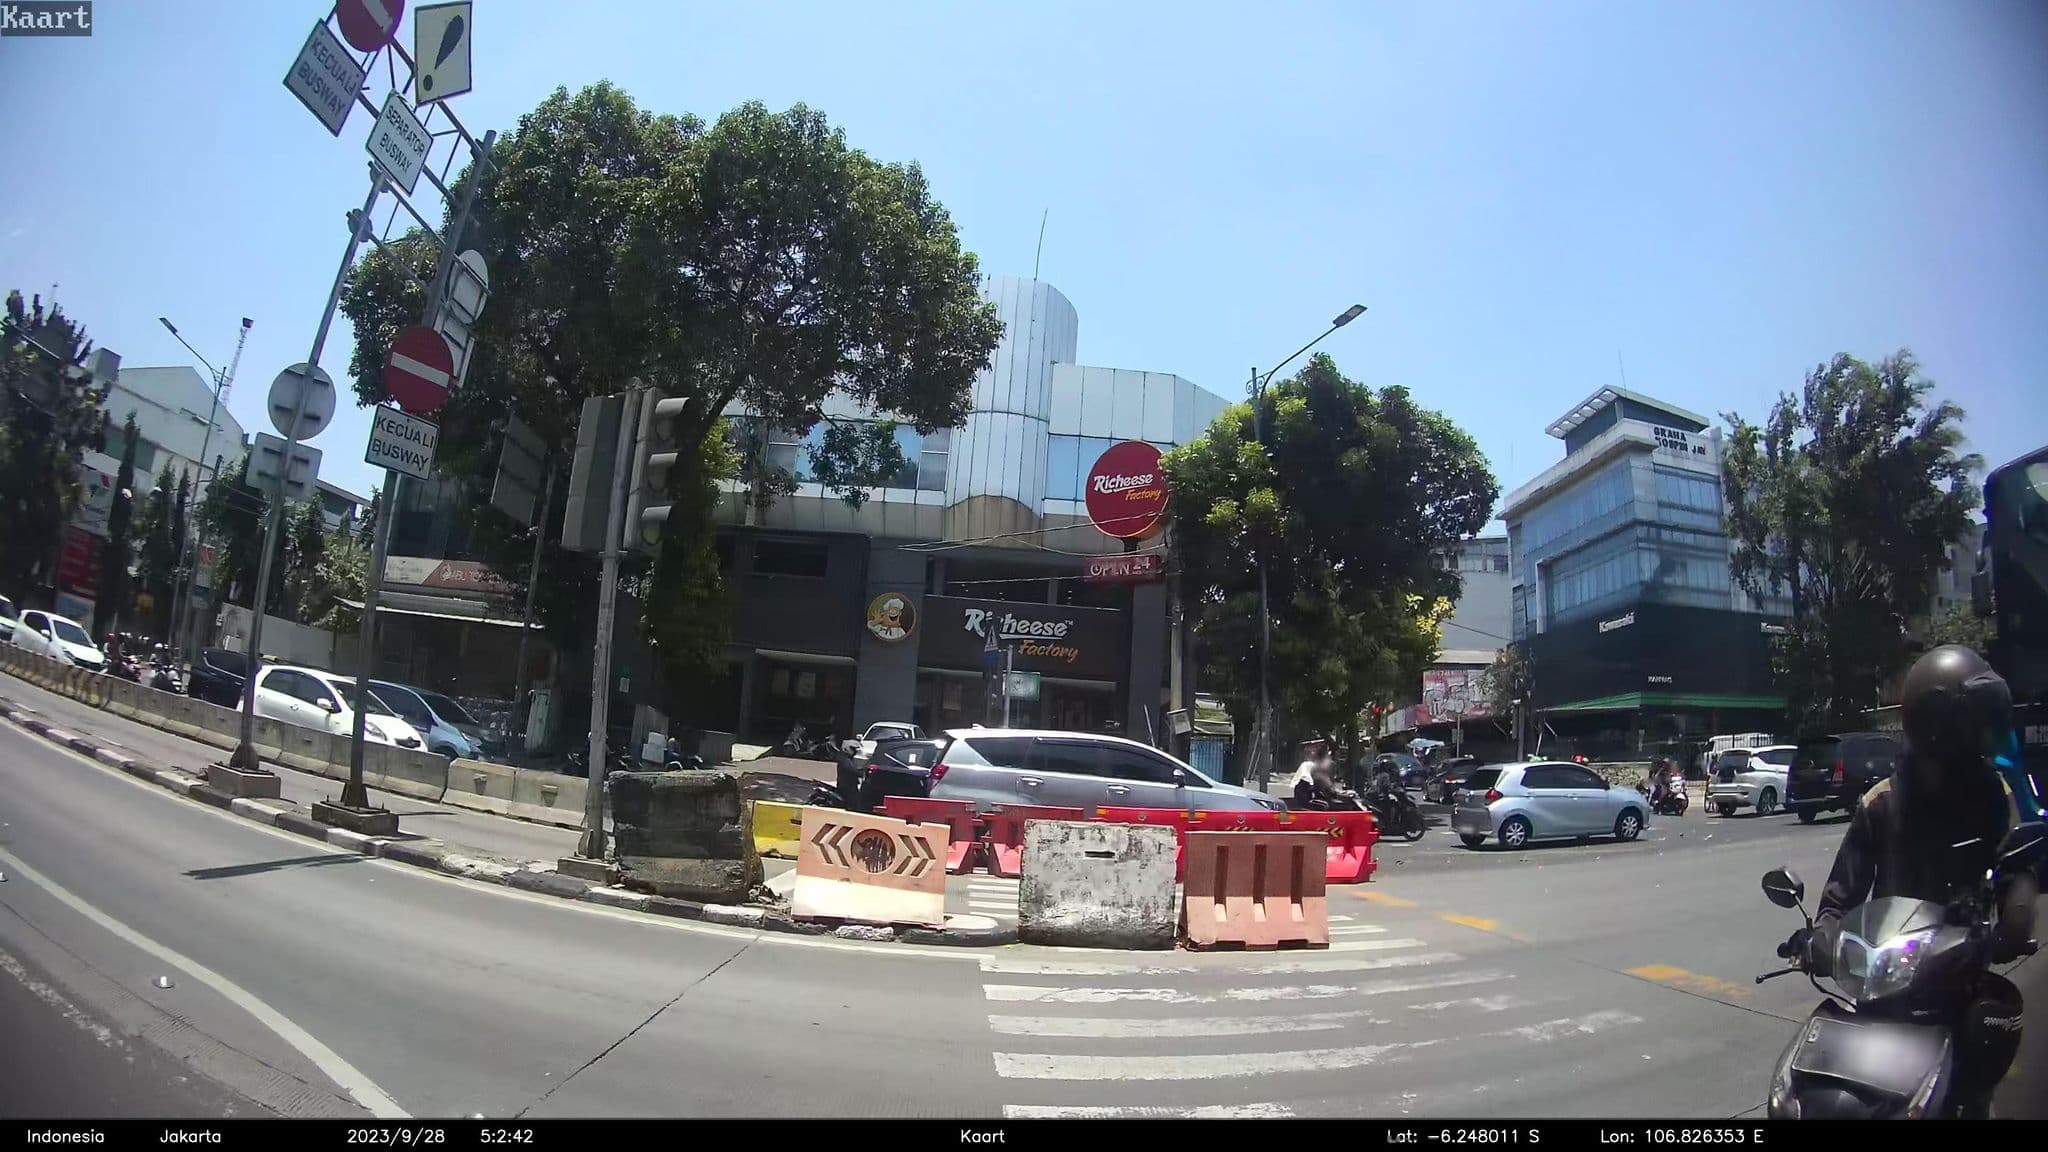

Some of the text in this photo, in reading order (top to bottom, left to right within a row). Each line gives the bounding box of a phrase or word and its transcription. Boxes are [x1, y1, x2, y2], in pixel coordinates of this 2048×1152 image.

[310, 37, 357, 97] KECUALI
[298, 61, 346, 117] BUSWAY
[386, 105, 425, 157] SEPARATOR
[379, 132, 412, 173] BUSWAY
[376, 416, 435, 449] KECUALI
[1653, 426, 1687, 442] GRAHA
[371, 438, 430, 472] BUSWAY
[1094, 473, 1154, 494] Richeese
[1125, 488, 1162, 501] Factory
[964, 608, 1068, 638] Riheese
[1018, 639, 1079, 663] Factory
